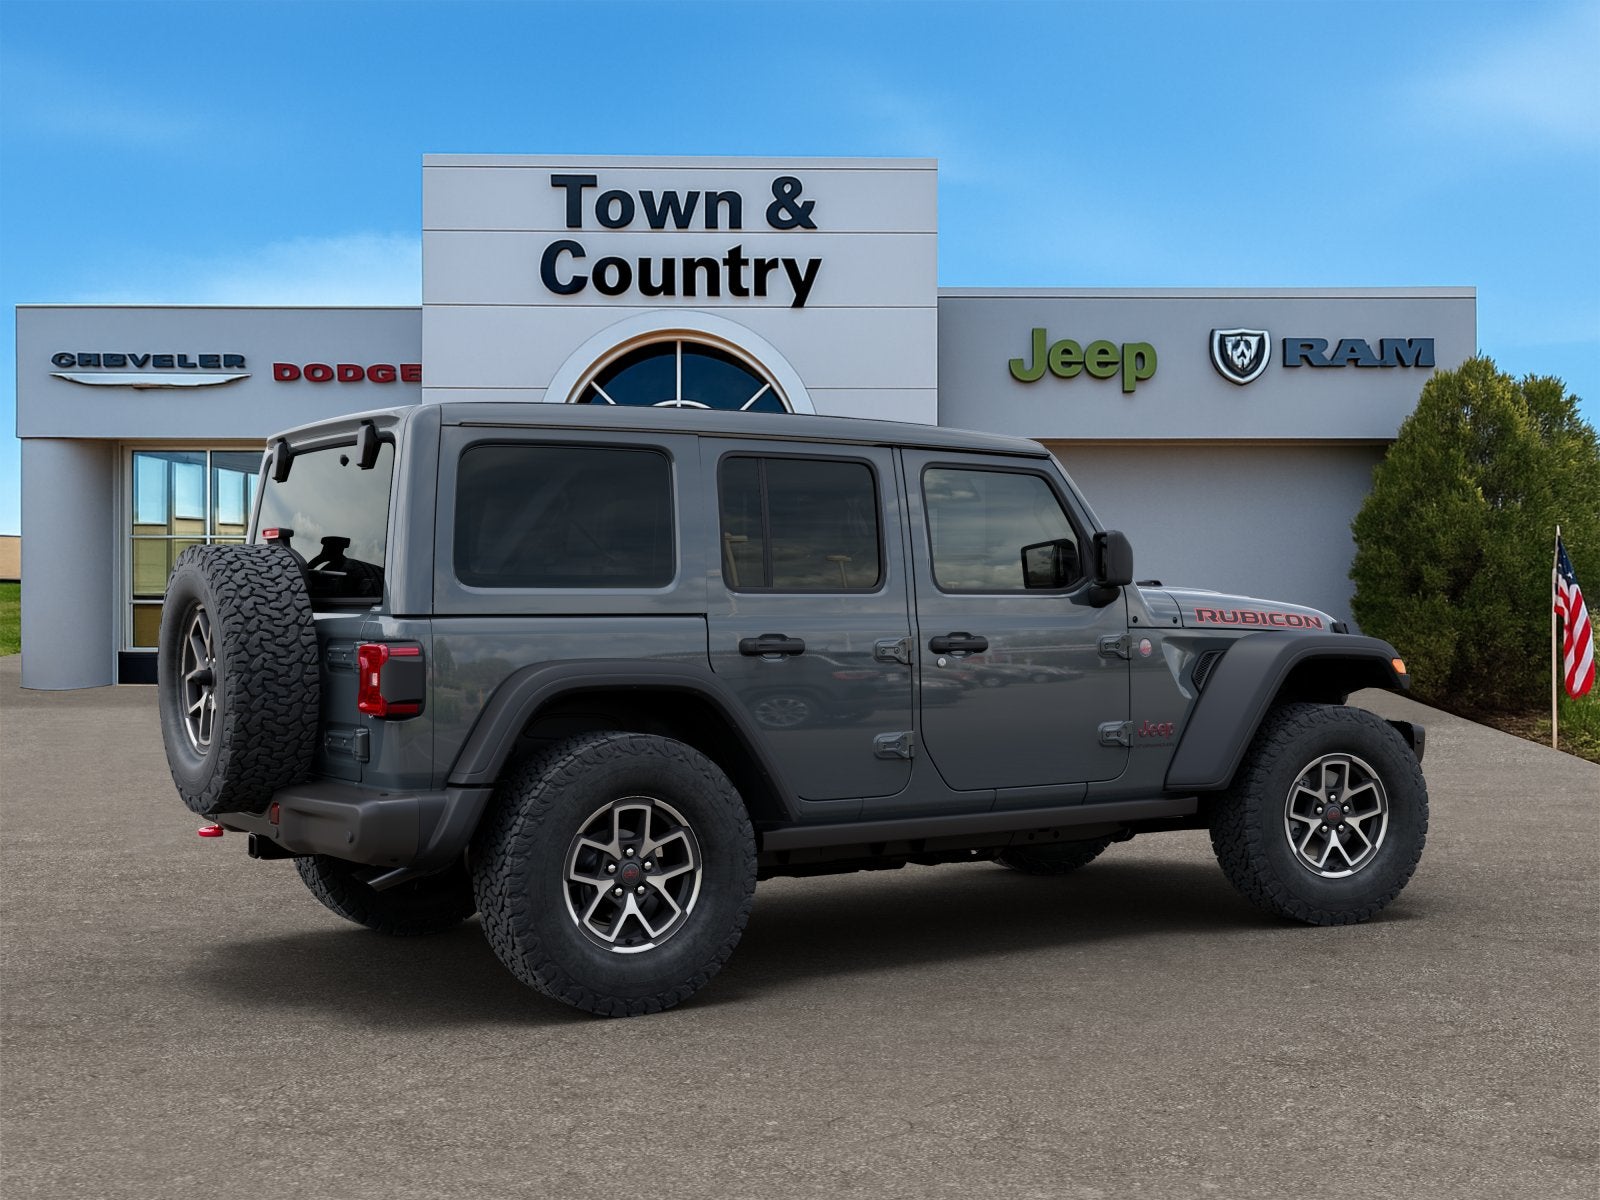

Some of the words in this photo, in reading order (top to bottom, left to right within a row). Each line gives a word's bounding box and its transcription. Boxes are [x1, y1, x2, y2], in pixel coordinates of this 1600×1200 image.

[551, 174, 743, 230] Town
[766, 176, 818, 230] &
[540, 239, 823, 308] Country
[1009, 327, 1158, 393] Jeep
[1282, 337, 1436, 368] RAM
[1194, 608, 1324, 630] RUBICON
[1138, 719, 1175, 739] Jeep
